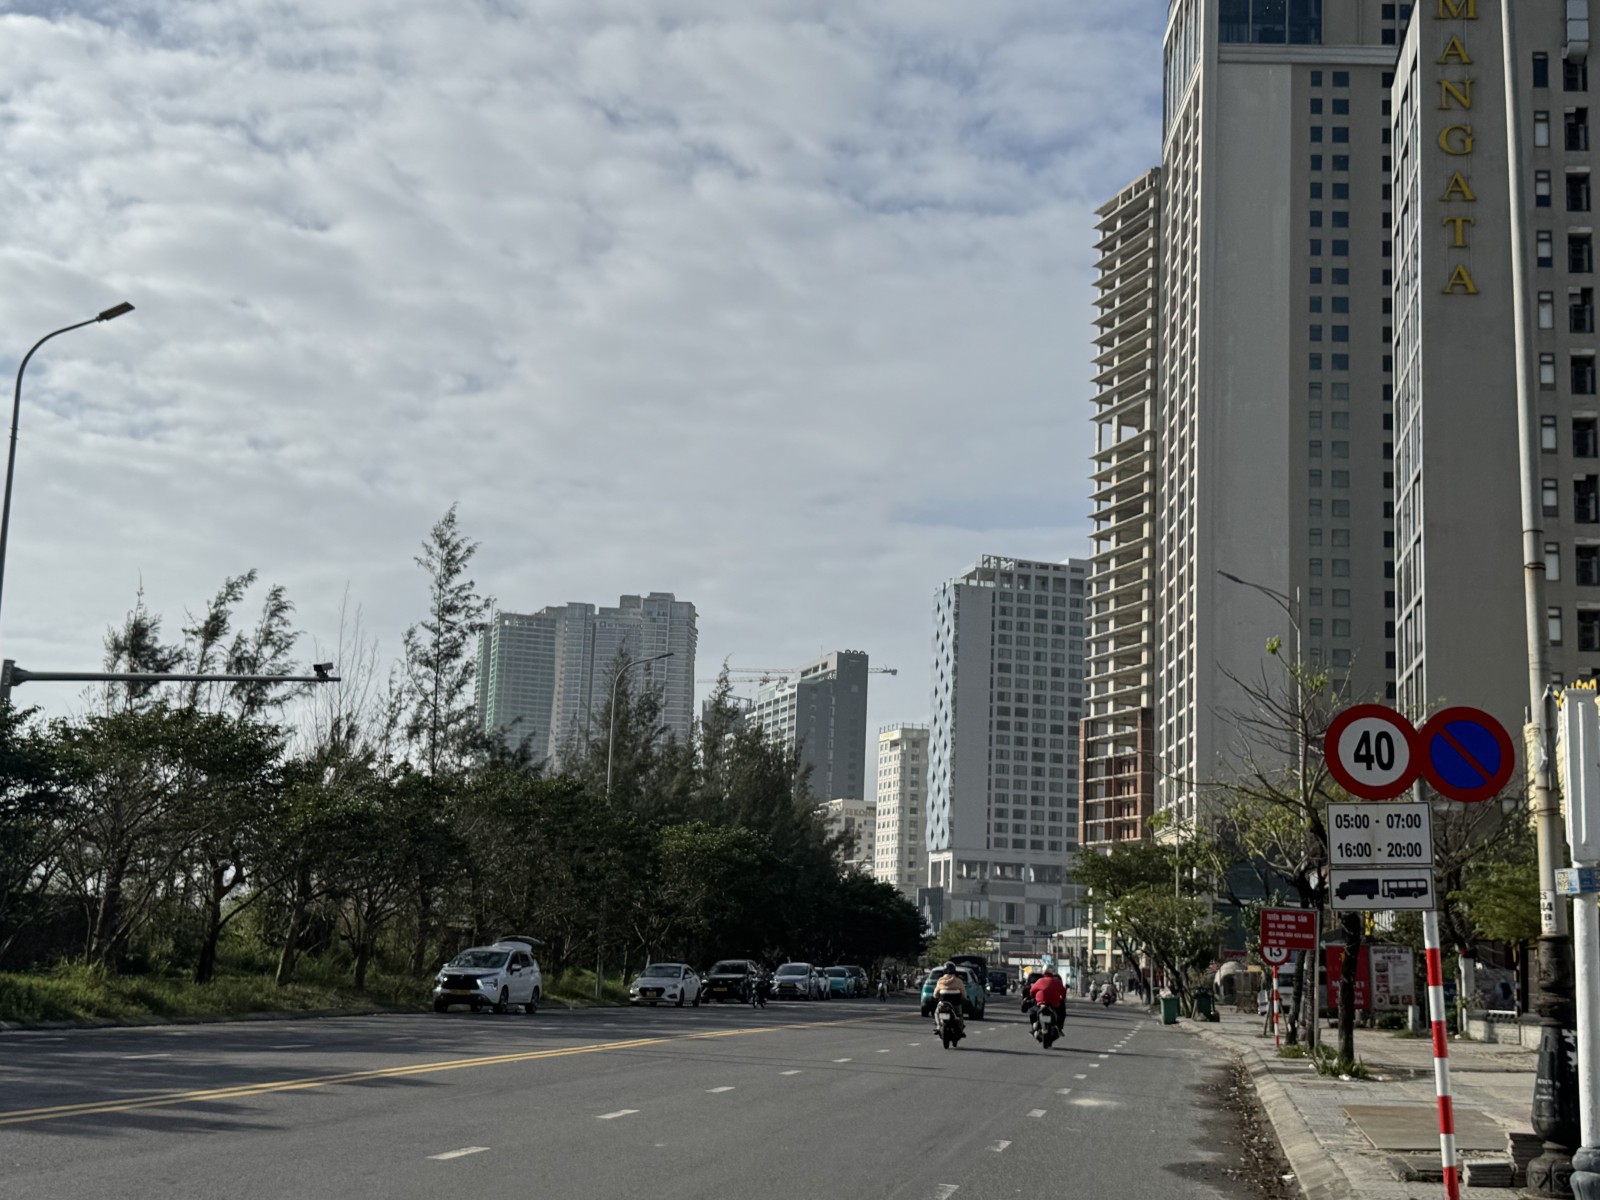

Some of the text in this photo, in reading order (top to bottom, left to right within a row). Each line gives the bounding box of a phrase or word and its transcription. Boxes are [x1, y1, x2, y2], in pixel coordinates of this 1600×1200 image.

[1434, 0, 1478, 294] MANGATA
[1353, 730, 1395, 771] 40
[1335, 814, 1370, 829] 05:00
[1386, 814, 1422, 829] 07:00
[1337, 842, 1372, 858] 16:00
[1387, 842, 1422, 857] 20:00
[1269, 947, 1283, 958] 13
